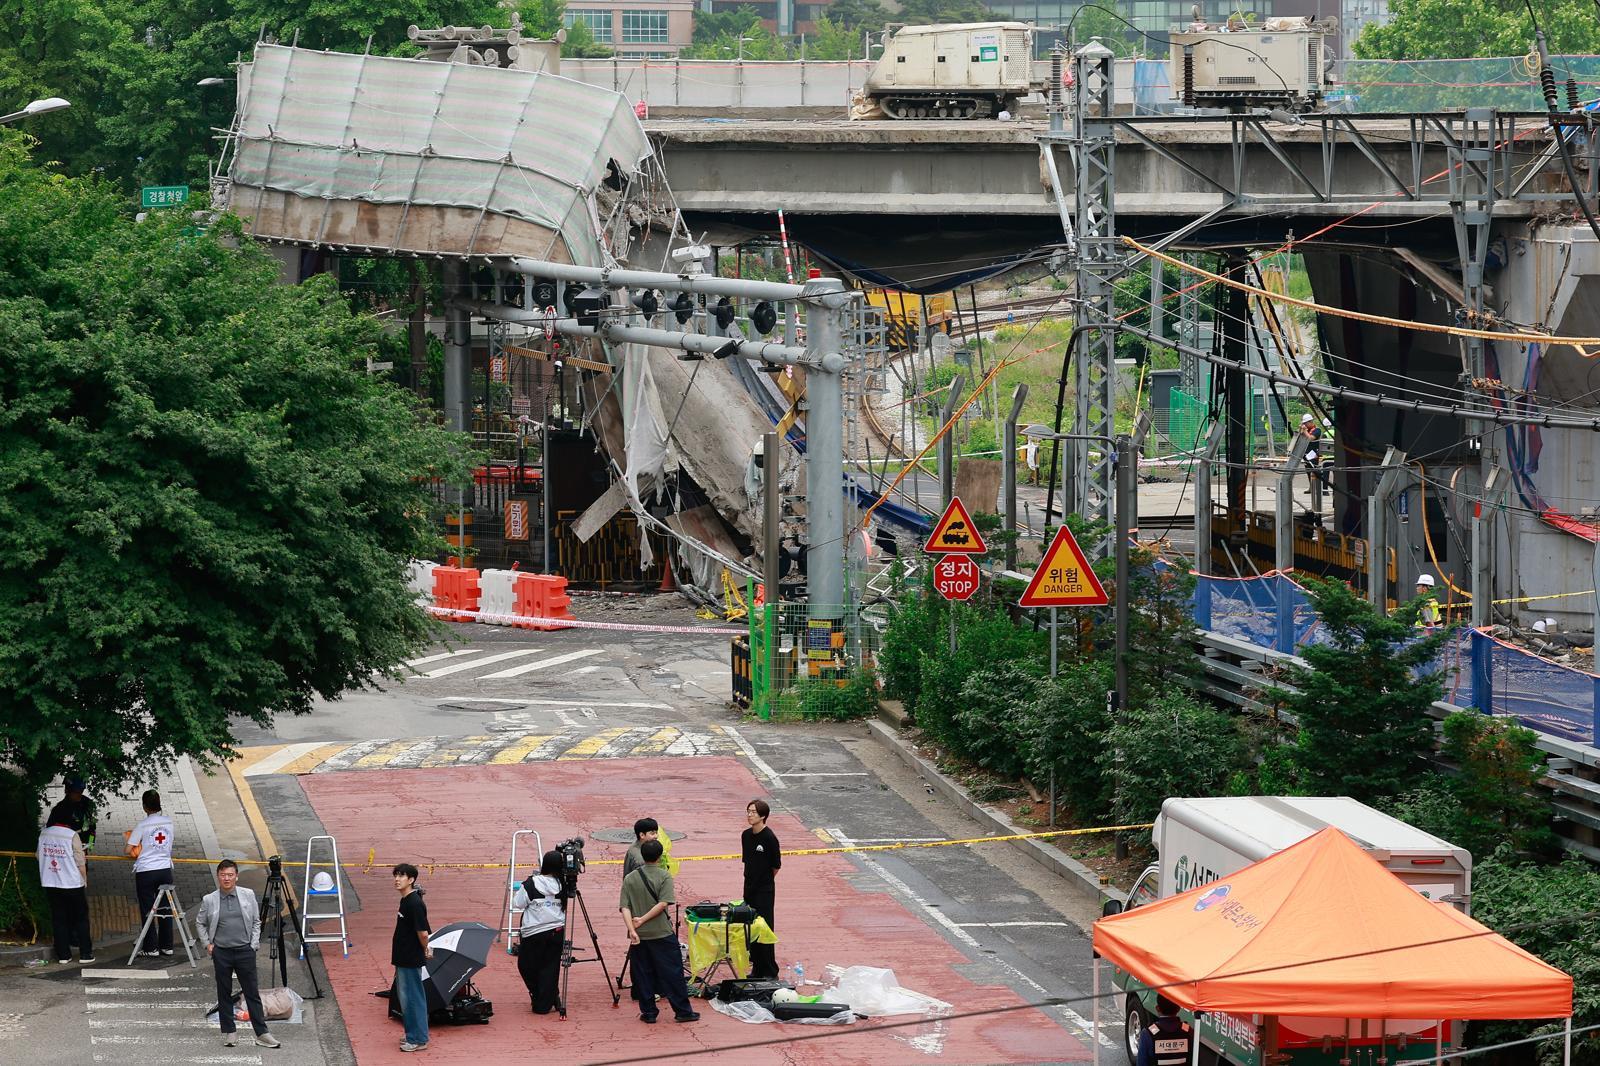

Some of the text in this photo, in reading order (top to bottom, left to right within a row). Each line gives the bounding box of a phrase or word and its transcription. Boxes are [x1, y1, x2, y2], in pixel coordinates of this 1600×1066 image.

[511, 504, 521, 535] 전기위험
[940, 561, 972, 578] 정지
[1049, 567, 1078, 584] 위험
[940, 581, 972, 593] STOP
[1043, 584, 1083, 594] DANGER
[1214, 1011, 1256, 1054] 통합지원본부
